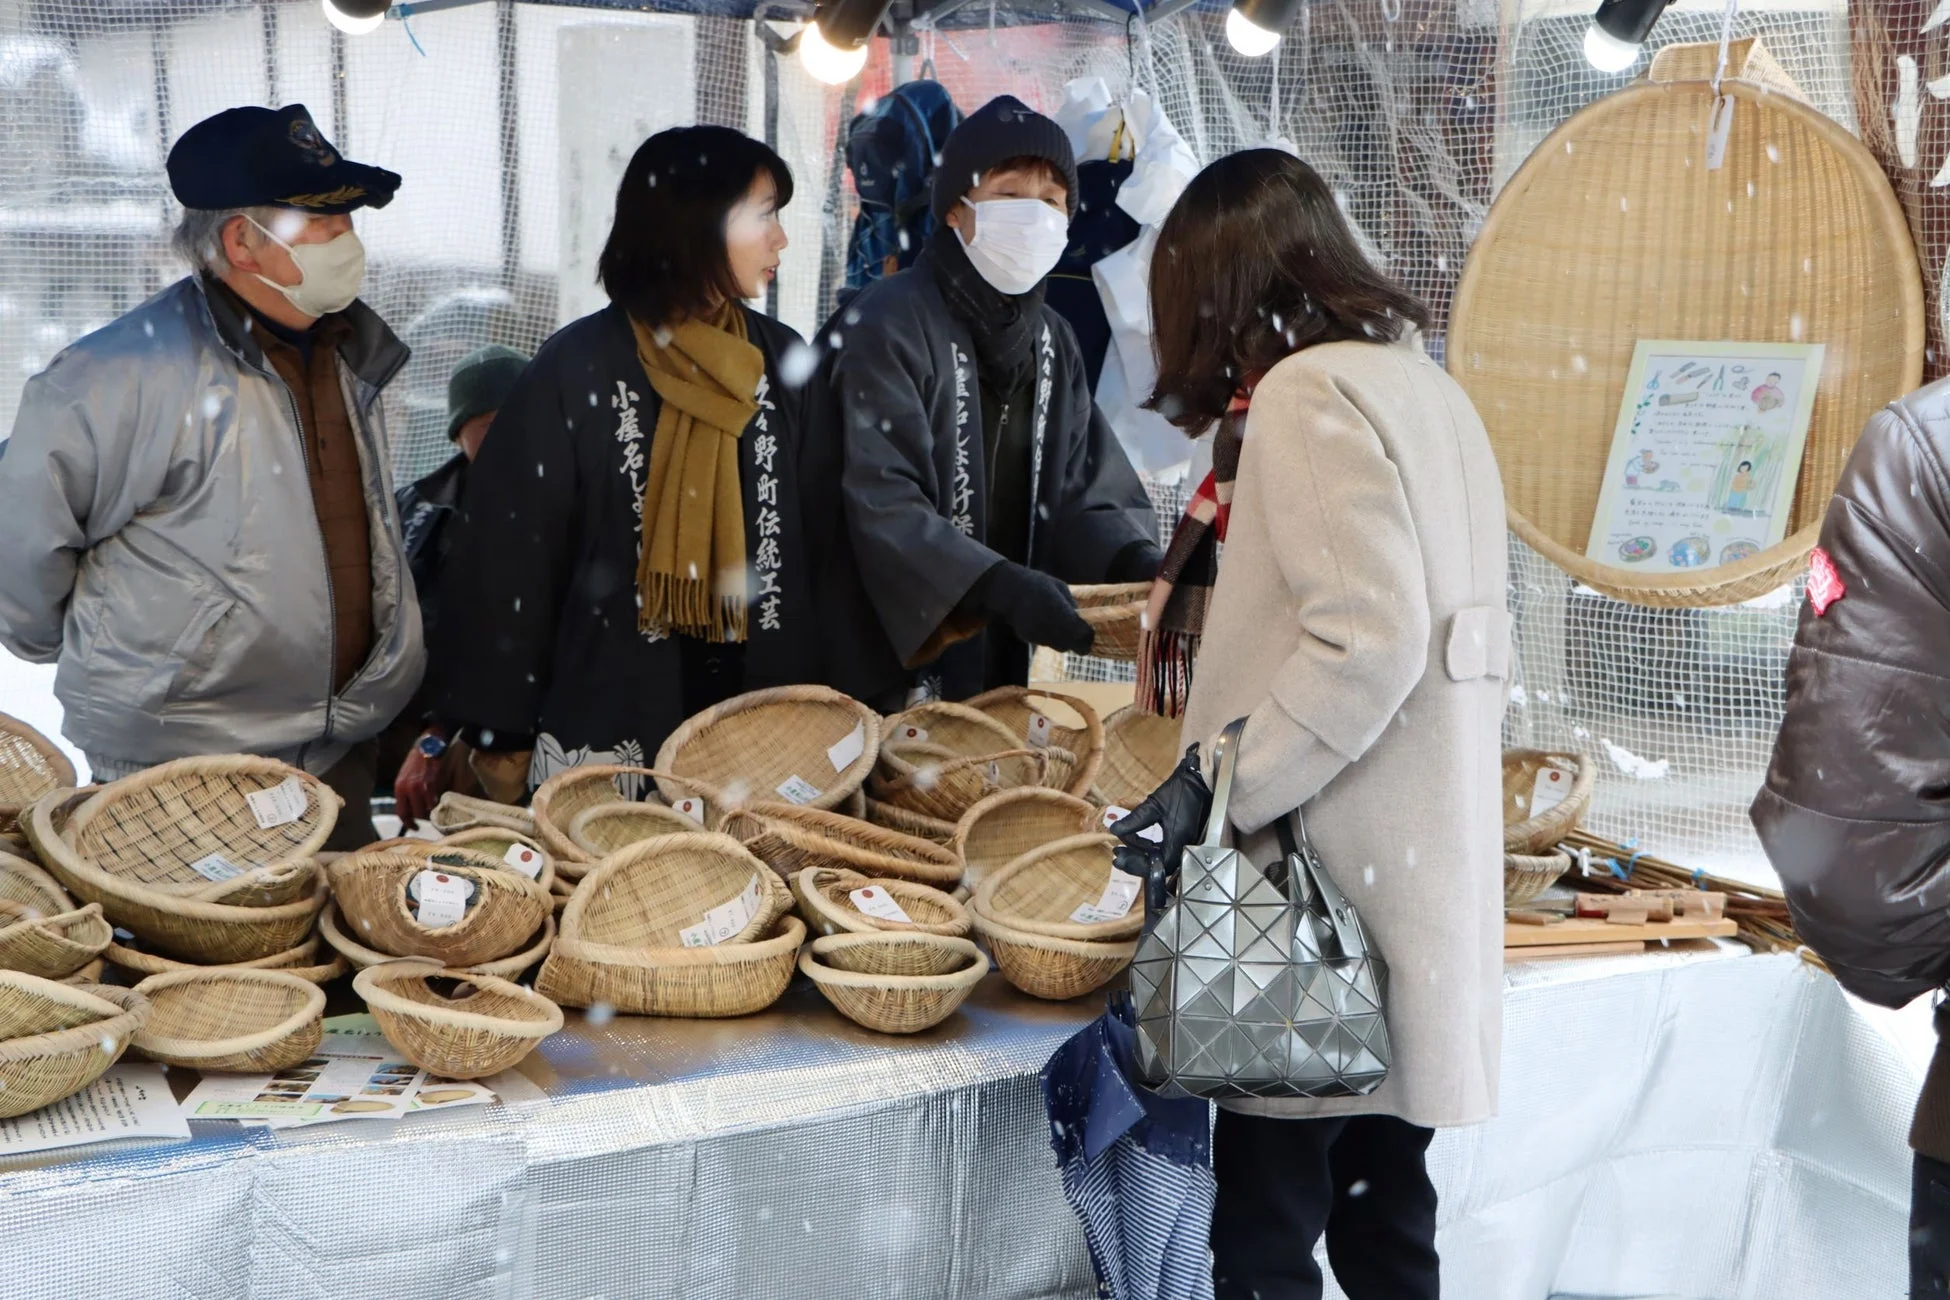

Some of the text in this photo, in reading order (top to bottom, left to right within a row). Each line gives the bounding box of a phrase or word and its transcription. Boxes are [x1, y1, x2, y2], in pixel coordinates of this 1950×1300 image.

[754, 374, 782, 630] 久々野町伝統工芸
